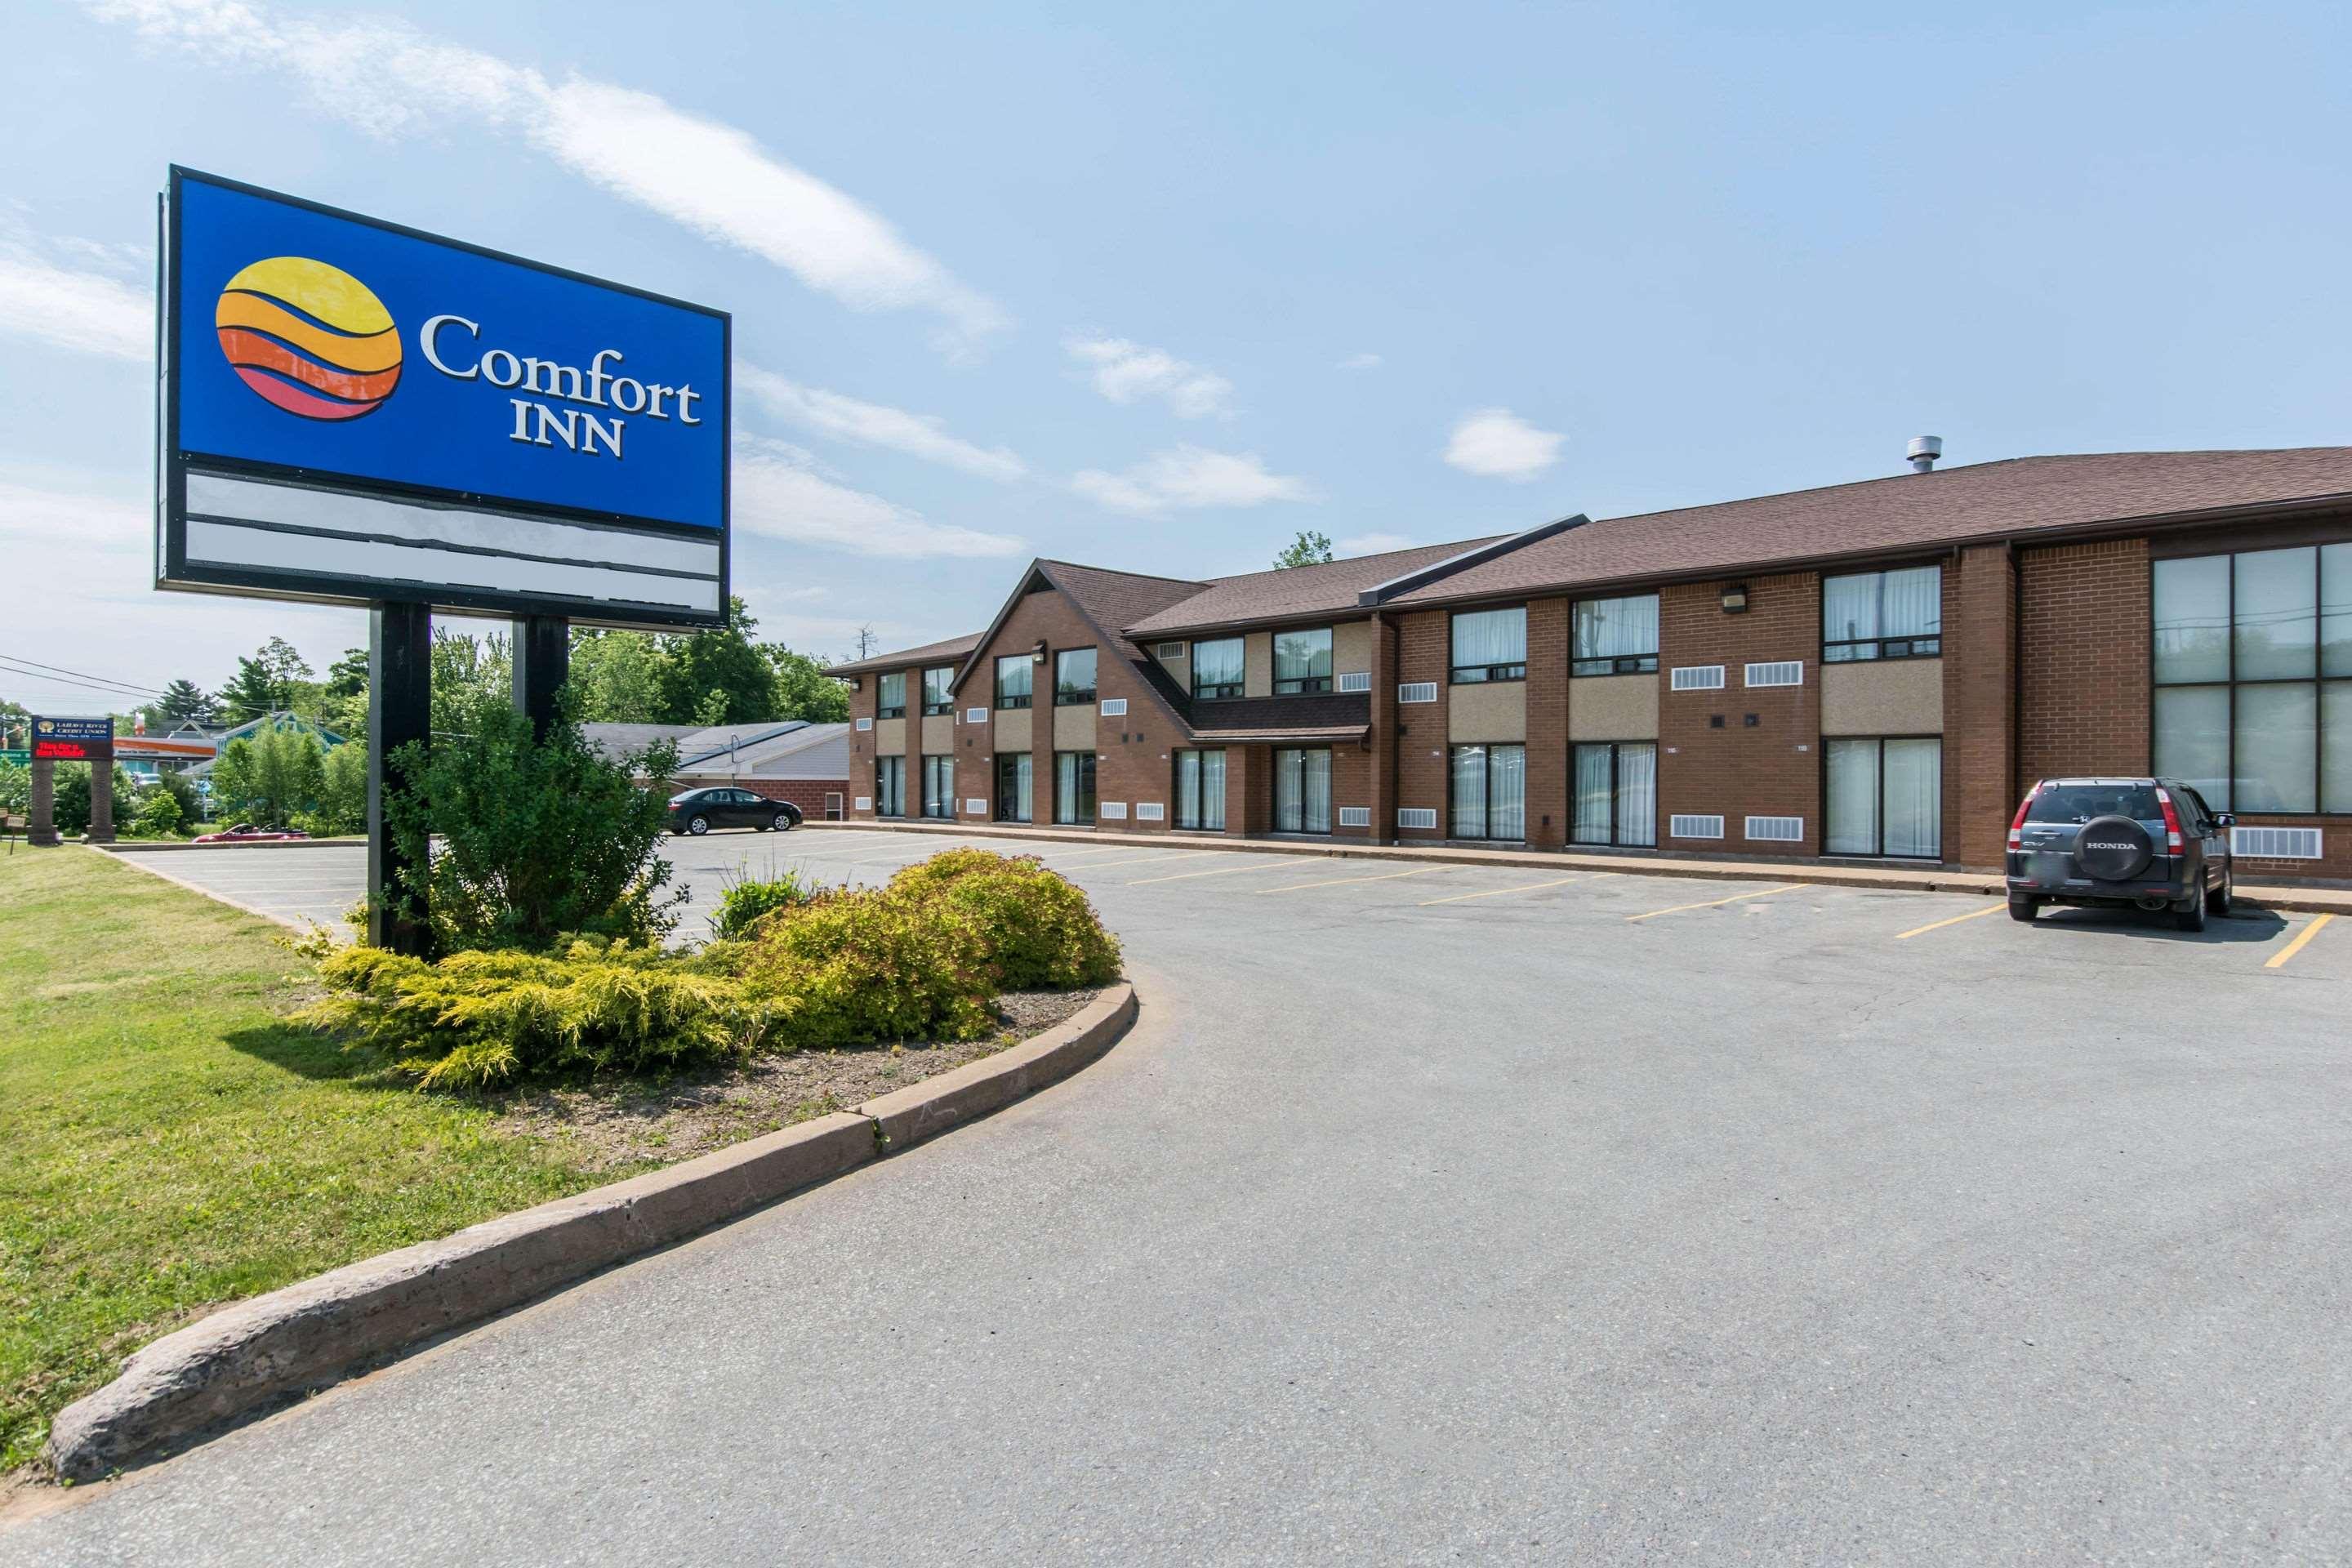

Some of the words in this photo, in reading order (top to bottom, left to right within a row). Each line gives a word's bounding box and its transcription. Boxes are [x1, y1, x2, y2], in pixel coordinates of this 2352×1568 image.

[420, 314, 701, 424] Comfort
[510, 398, 626, 457] INN
[2086, 842, 2139, 850] HONDA
